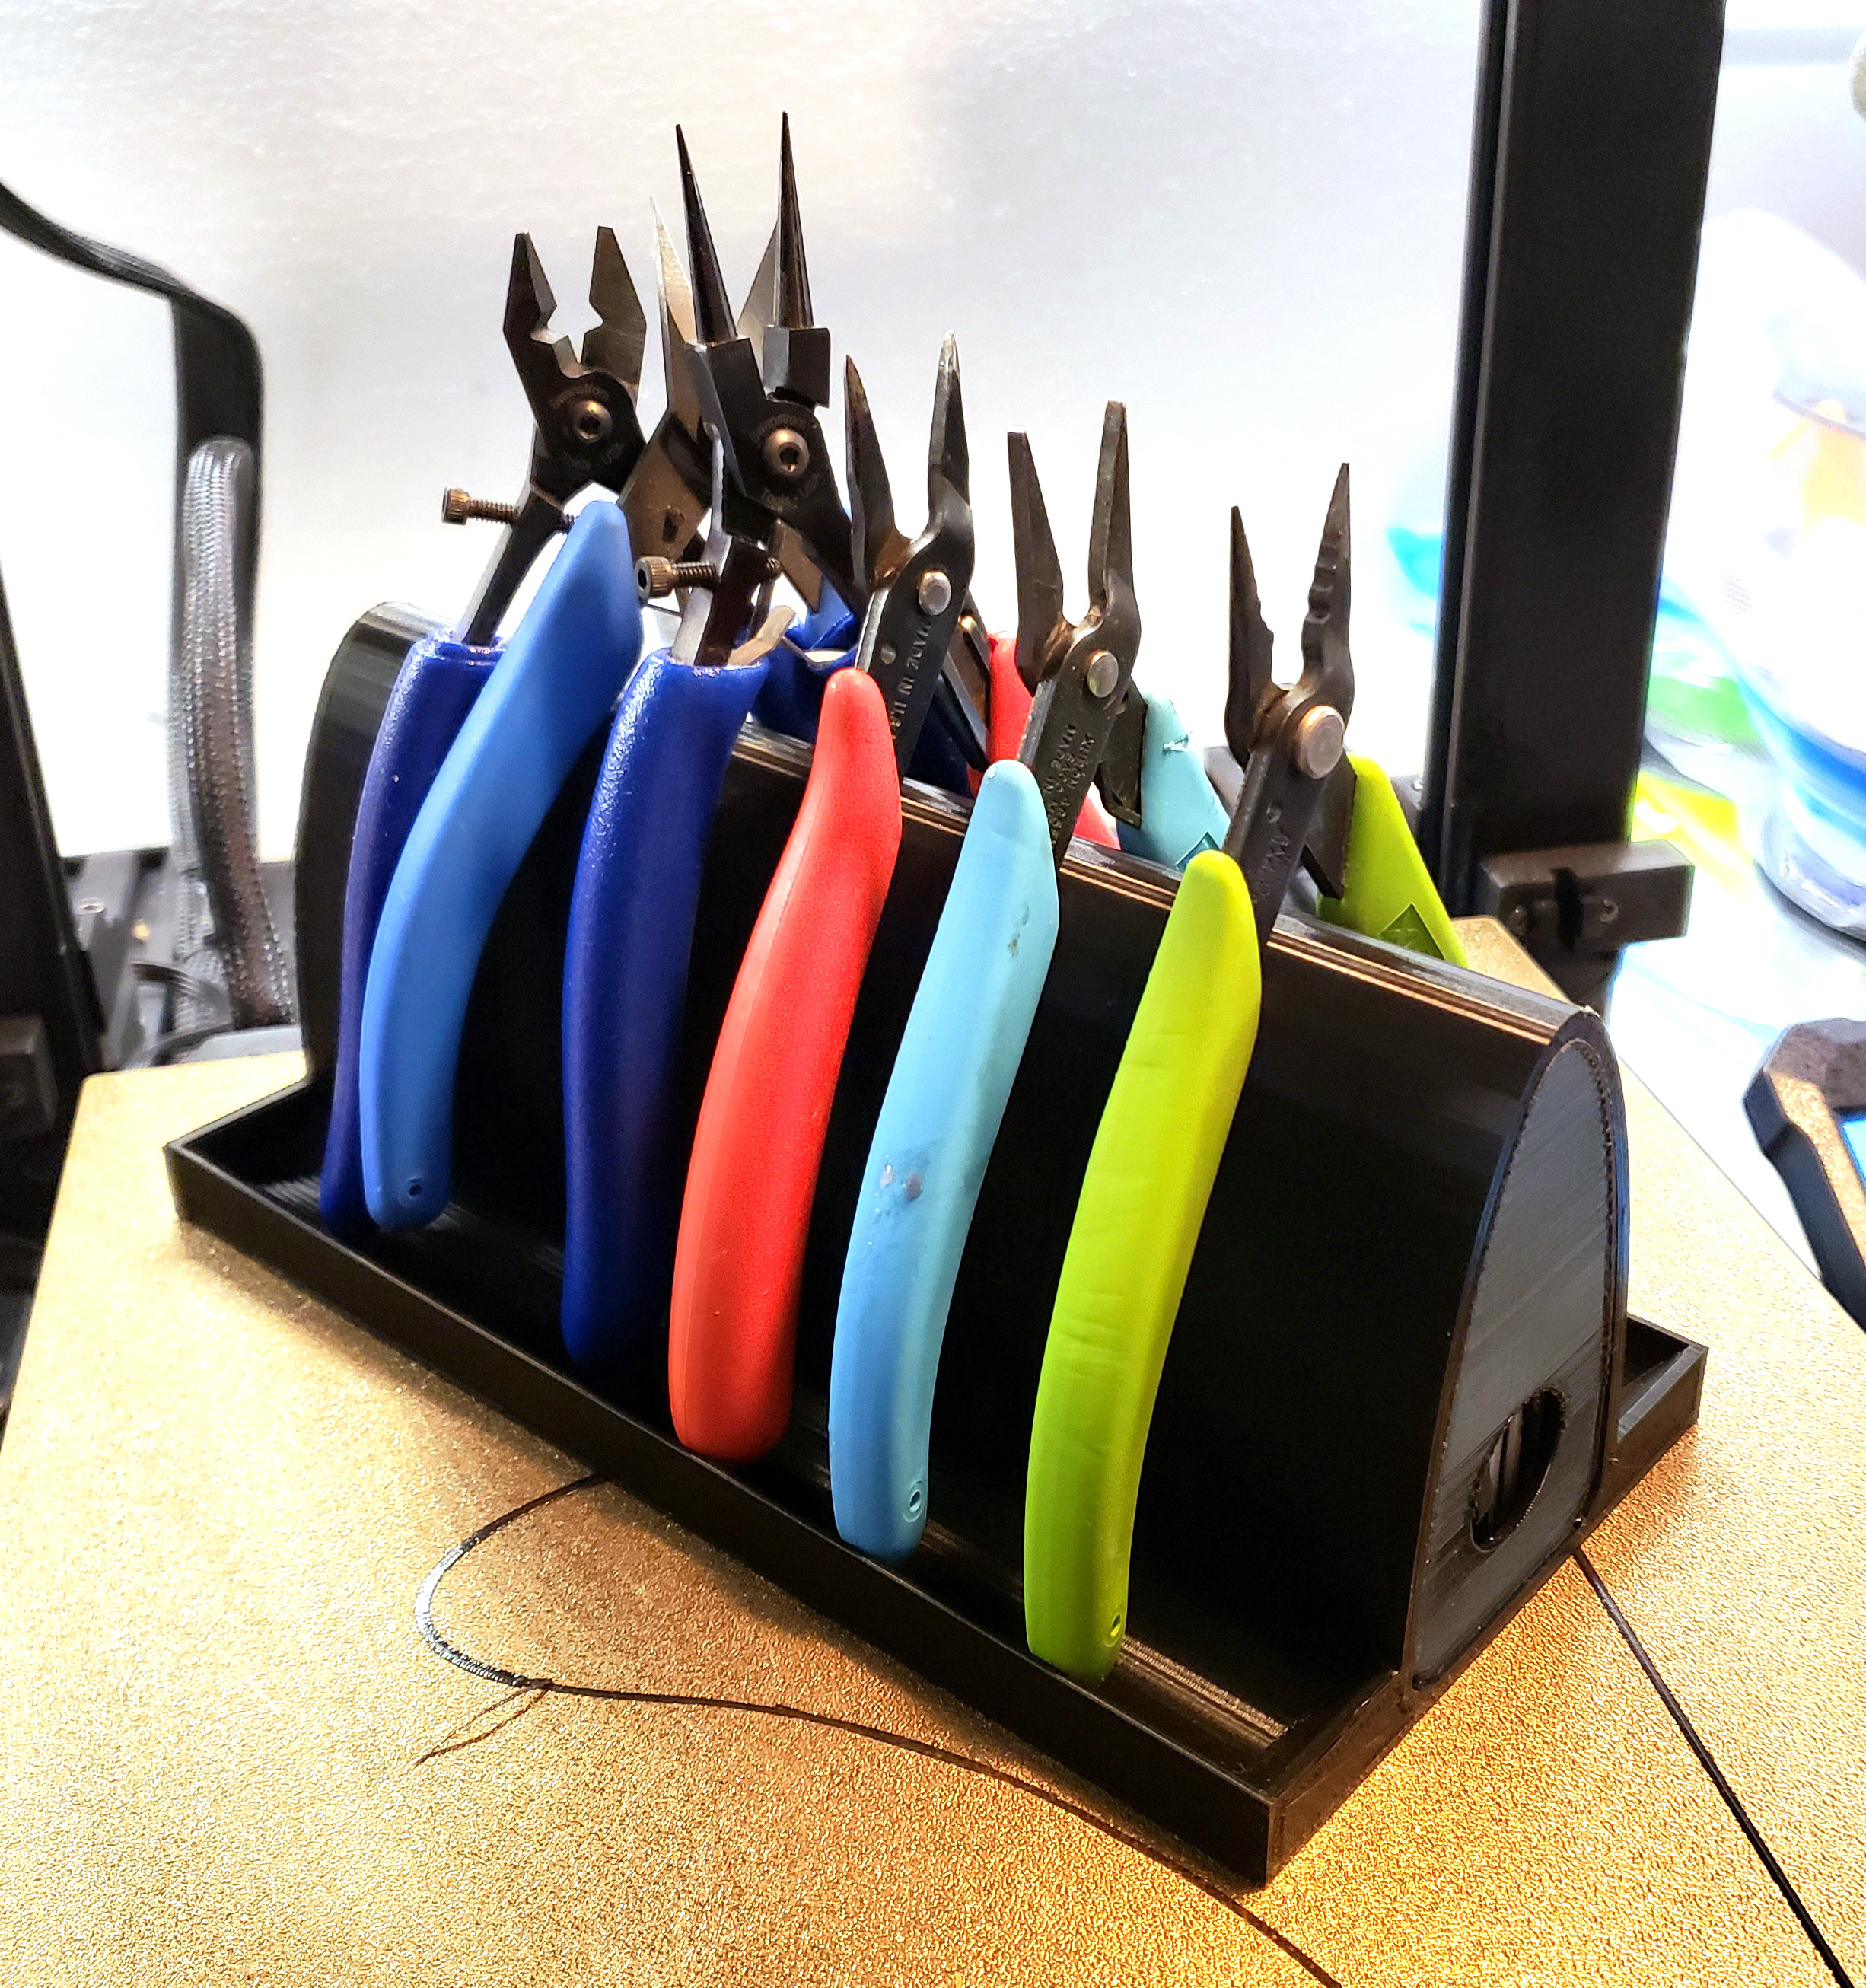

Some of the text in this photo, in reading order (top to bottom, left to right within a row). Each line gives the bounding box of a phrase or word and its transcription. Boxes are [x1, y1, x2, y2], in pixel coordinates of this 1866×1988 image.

[907, 622, 931, 670] MADE
[898, 676, 914, 695] IN
[1051, 725, 1076, 769] MADE
[1065, 733, 1094, 789] XURON
